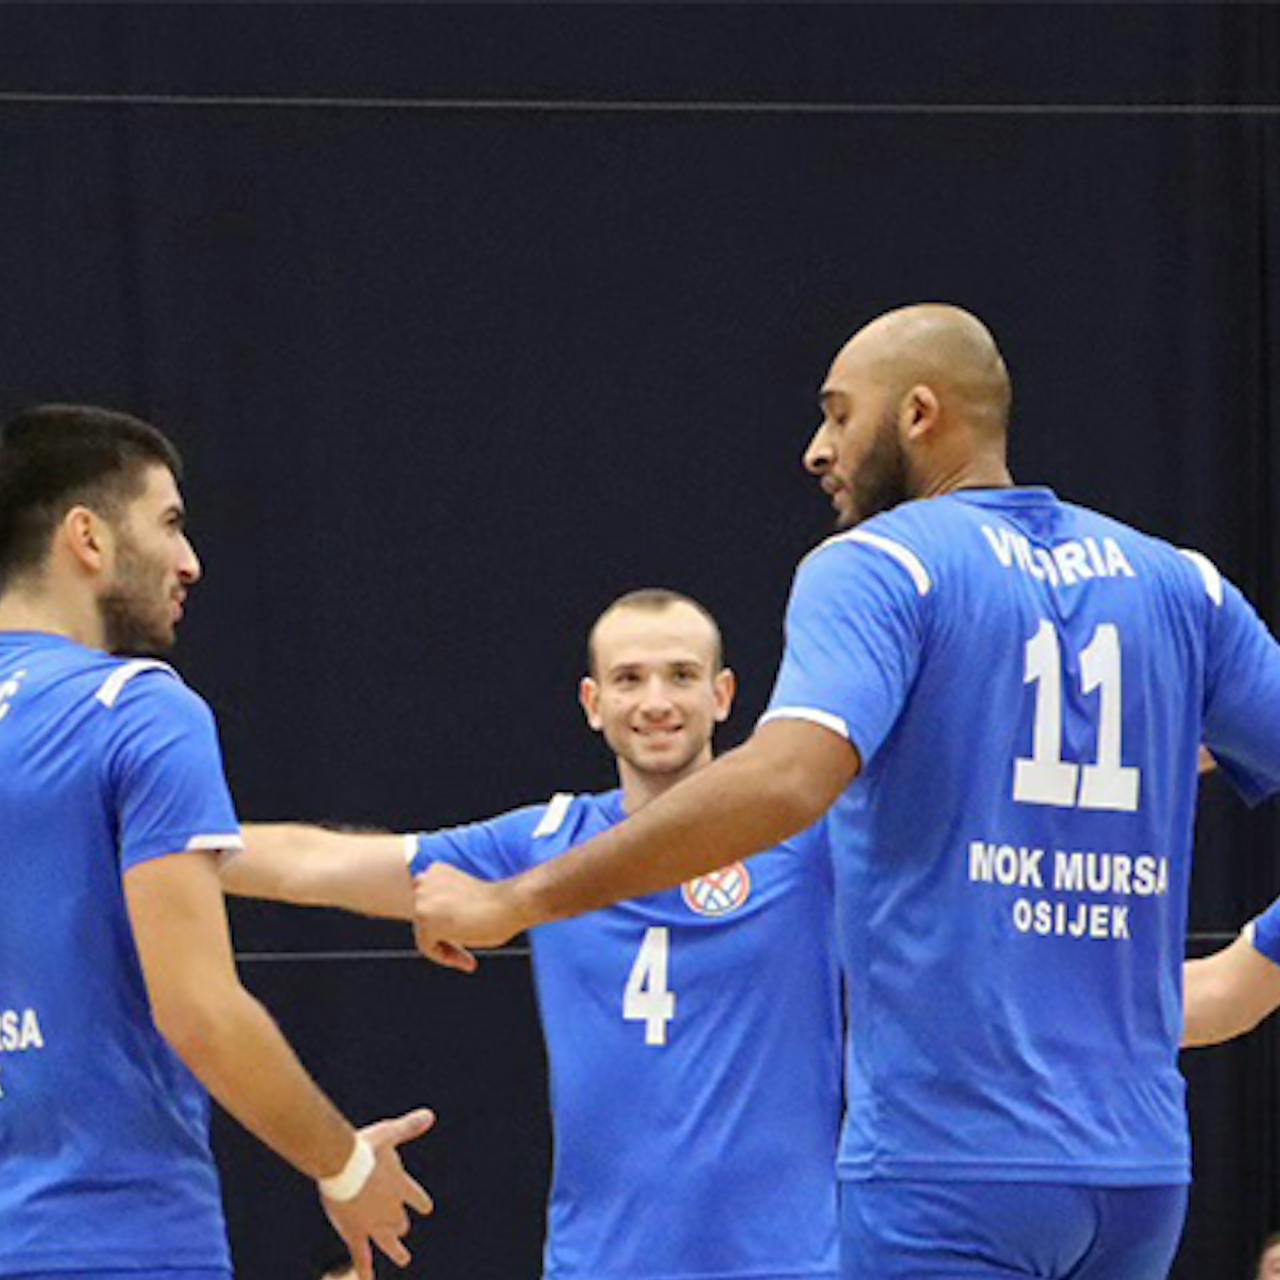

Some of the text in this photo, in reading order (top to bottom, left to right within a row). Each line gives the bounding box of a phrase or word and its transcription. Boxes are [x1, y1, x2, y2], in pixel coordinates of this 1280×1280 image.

[1012, 619, 1141, 812] 11
[969, 840, 1044, 886] NOK
[1013, 899, 1131, 939] OSIJEK
[622, 926, 676, 1046] 4
